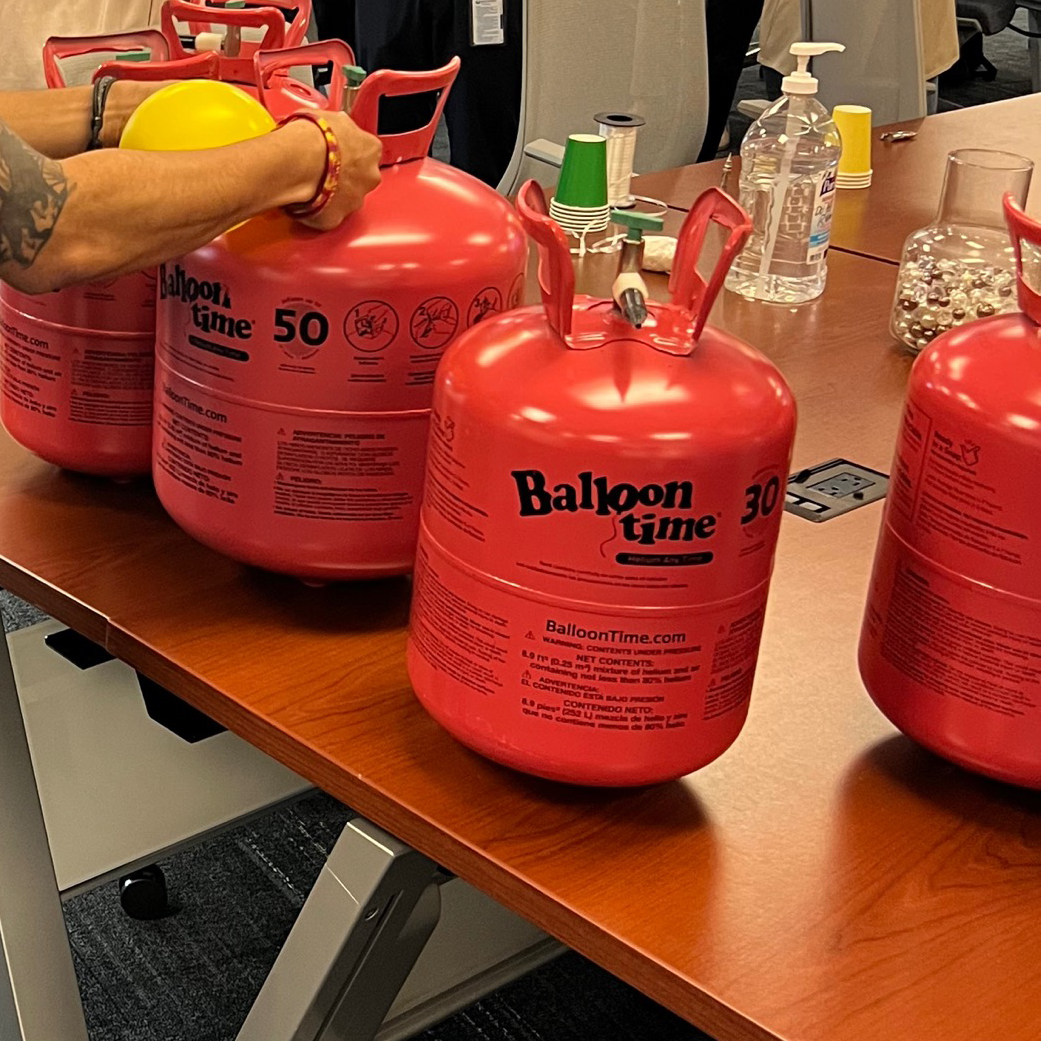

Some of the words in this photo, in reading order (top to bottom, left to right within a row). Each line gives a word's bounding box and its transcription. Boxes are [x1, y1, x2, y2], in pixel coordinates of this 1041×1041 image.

[160, 263, 231, 309] Balloon
[190, 302, 253, 339] time
[273, 308, 329, 346] 50
[511, 469, 693, 517] Balloon
[740, 475, 779, 526] 30
[619, 513, 716, 545] time
[545, 619, 686, 644] BalloonTime.com
[576, 654, 597, 663] NET
[563, 699, 623, 713] CONTENIDO
